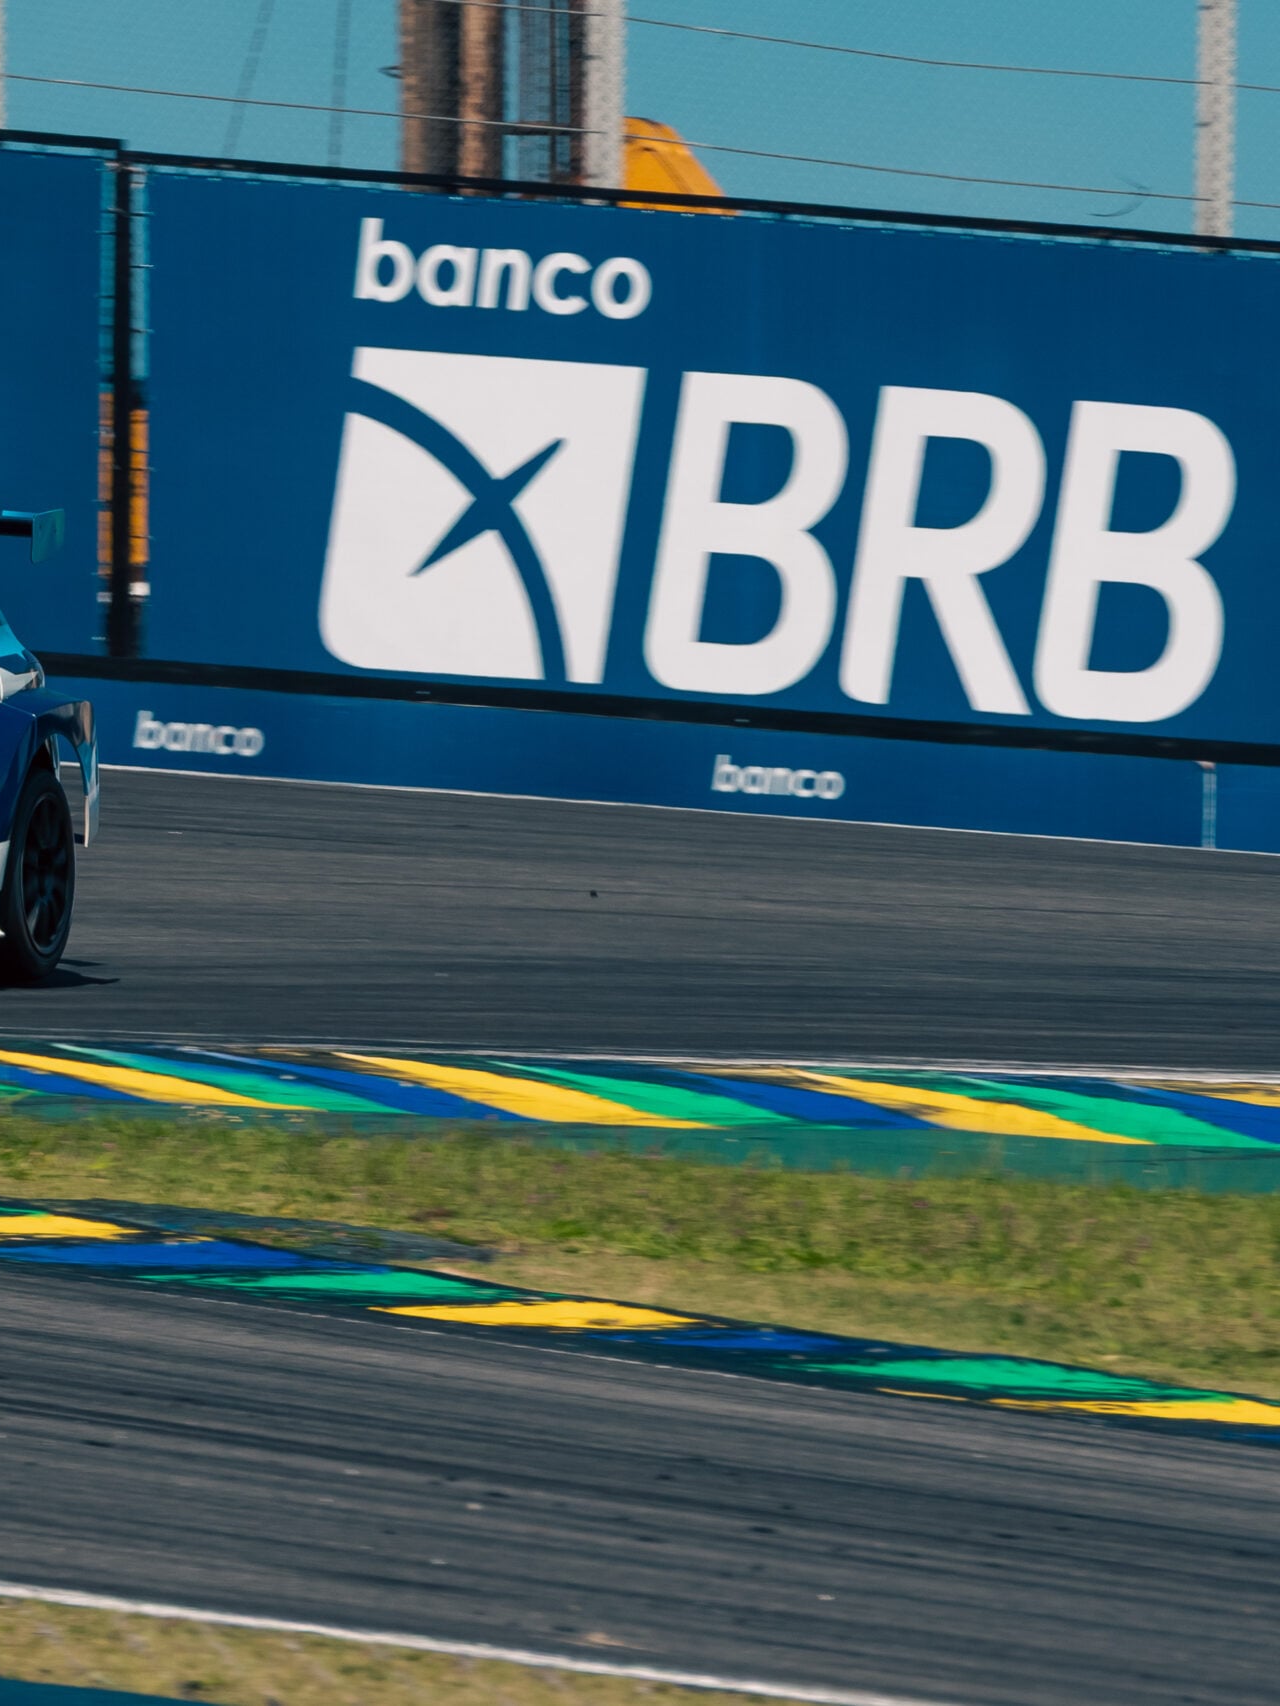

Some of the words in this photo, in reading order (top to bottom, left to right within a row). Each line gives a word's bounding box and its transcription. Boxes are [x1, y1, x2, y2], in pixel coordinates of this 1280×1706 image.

[353, 216, 652, 321] banco
[643, 370, 1237, 723] BRB
[132, 710, 265, 757] banco
[711, 754, 845, 800] banco
